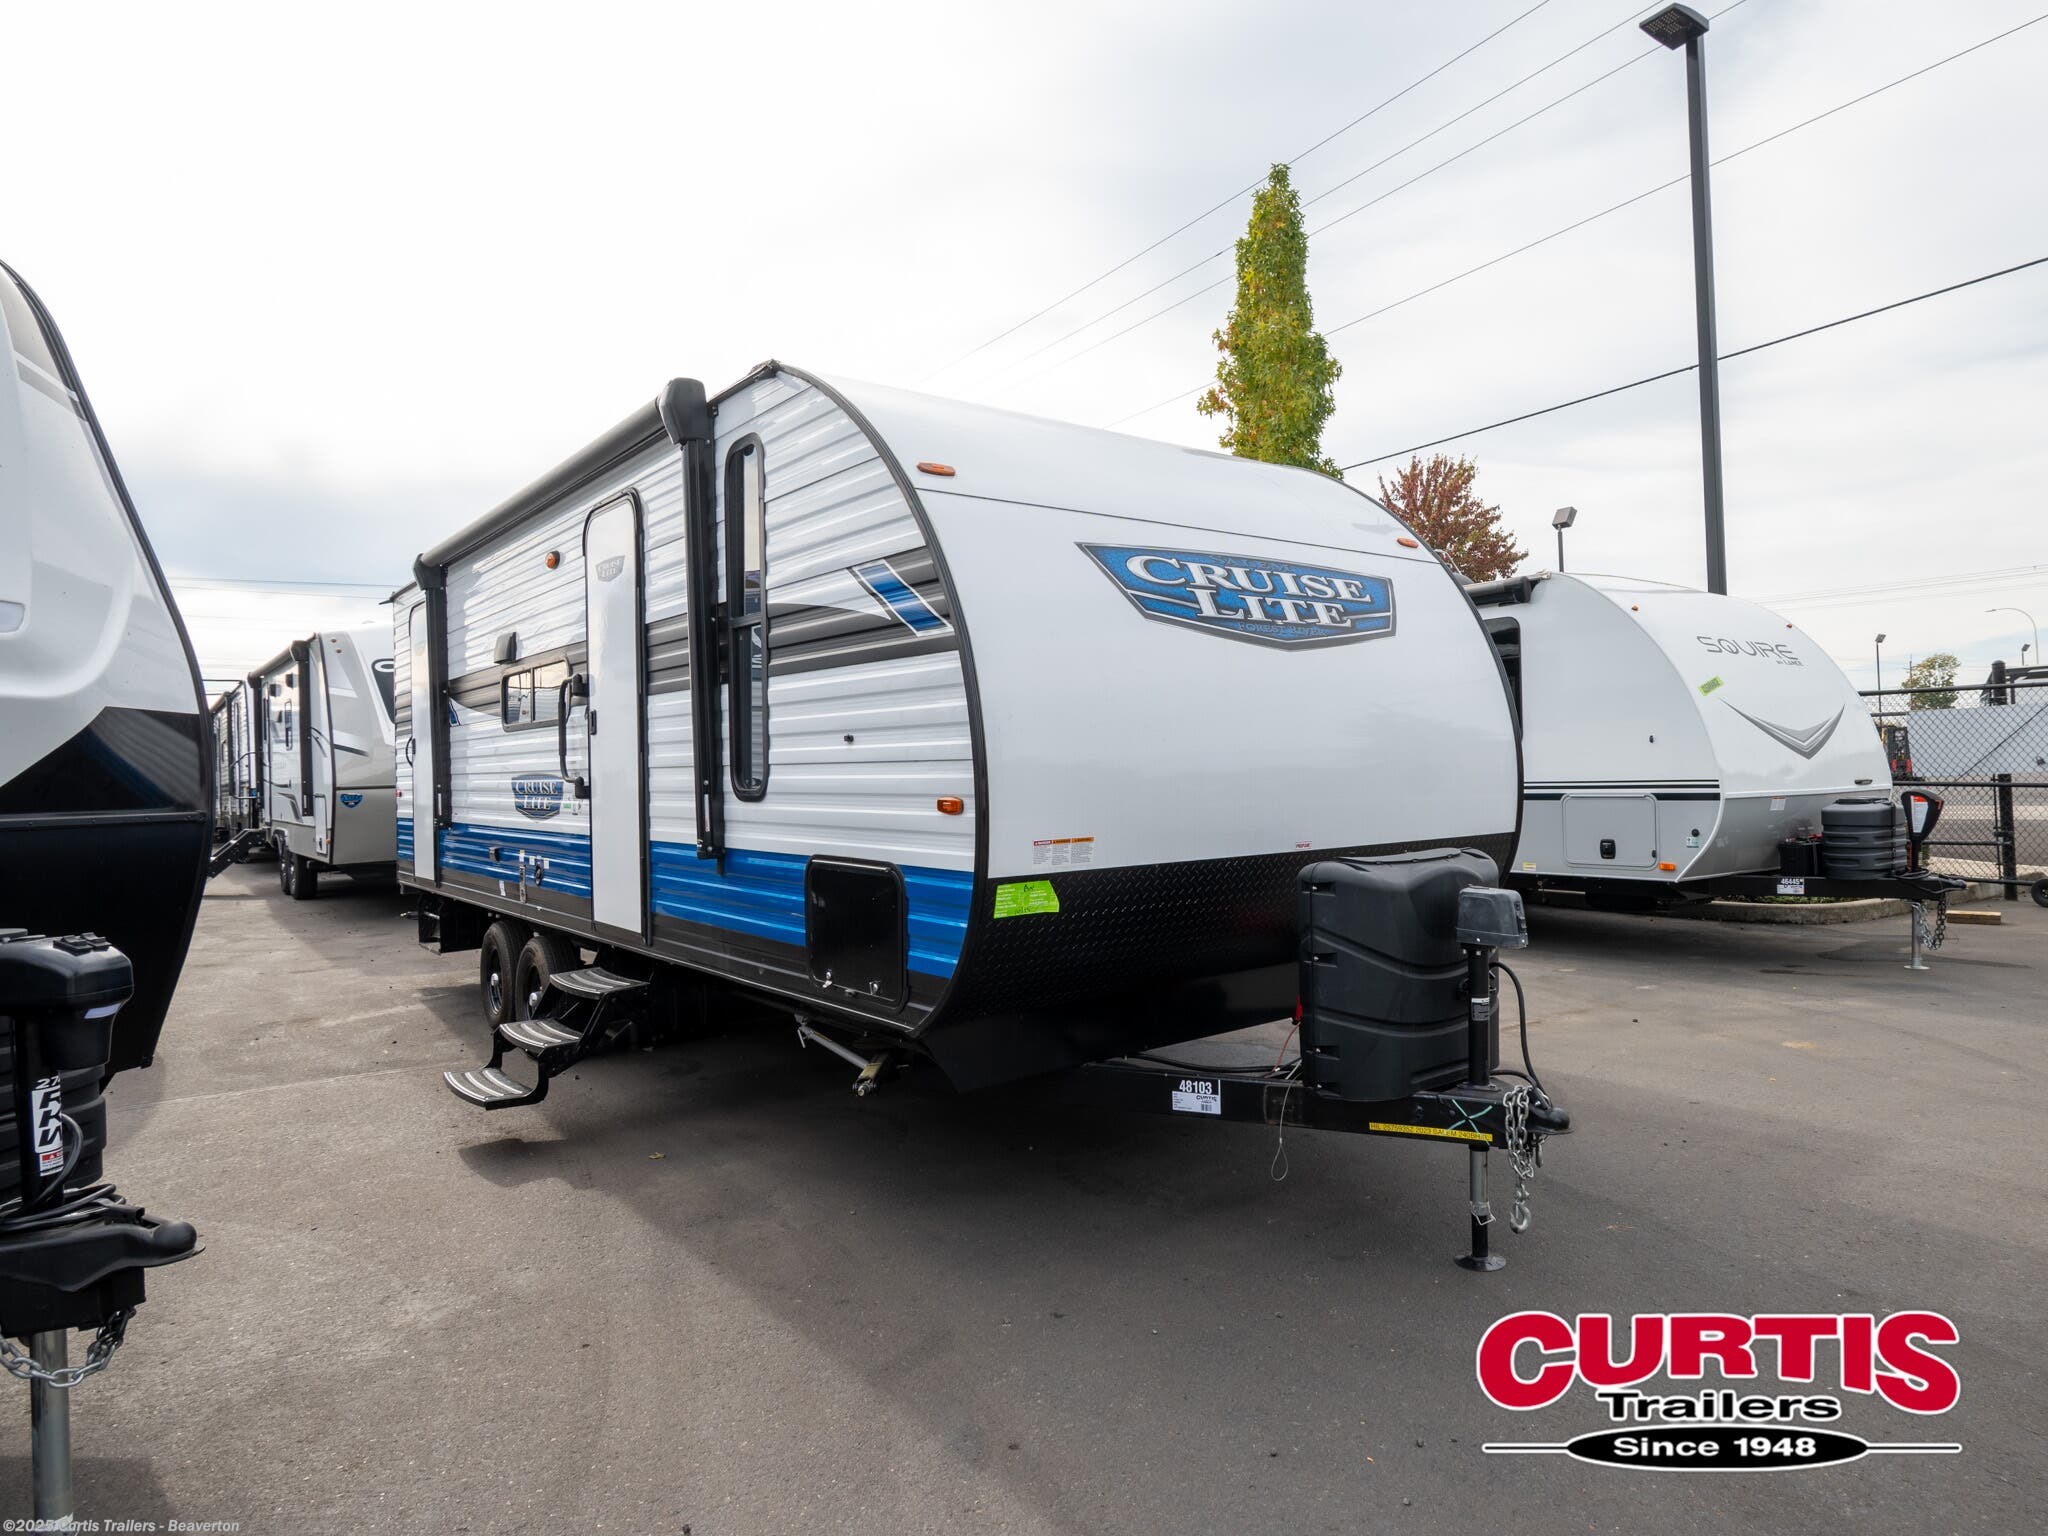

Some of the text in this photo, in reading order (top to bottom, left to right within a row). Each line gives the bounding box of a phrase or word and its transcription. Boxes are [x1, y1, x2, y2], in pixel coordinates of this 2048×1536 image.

[1126, 555, 1371, 602] CRUISE
[1185, 587, 1351, 628] LITE
[1696, 635, 1799, 661] SQUIRE
[516, 781, 557, 794] CRUISE
[523, 795, 551, 809] LITE
[1179, 1080, 1212, 1094] 48103
